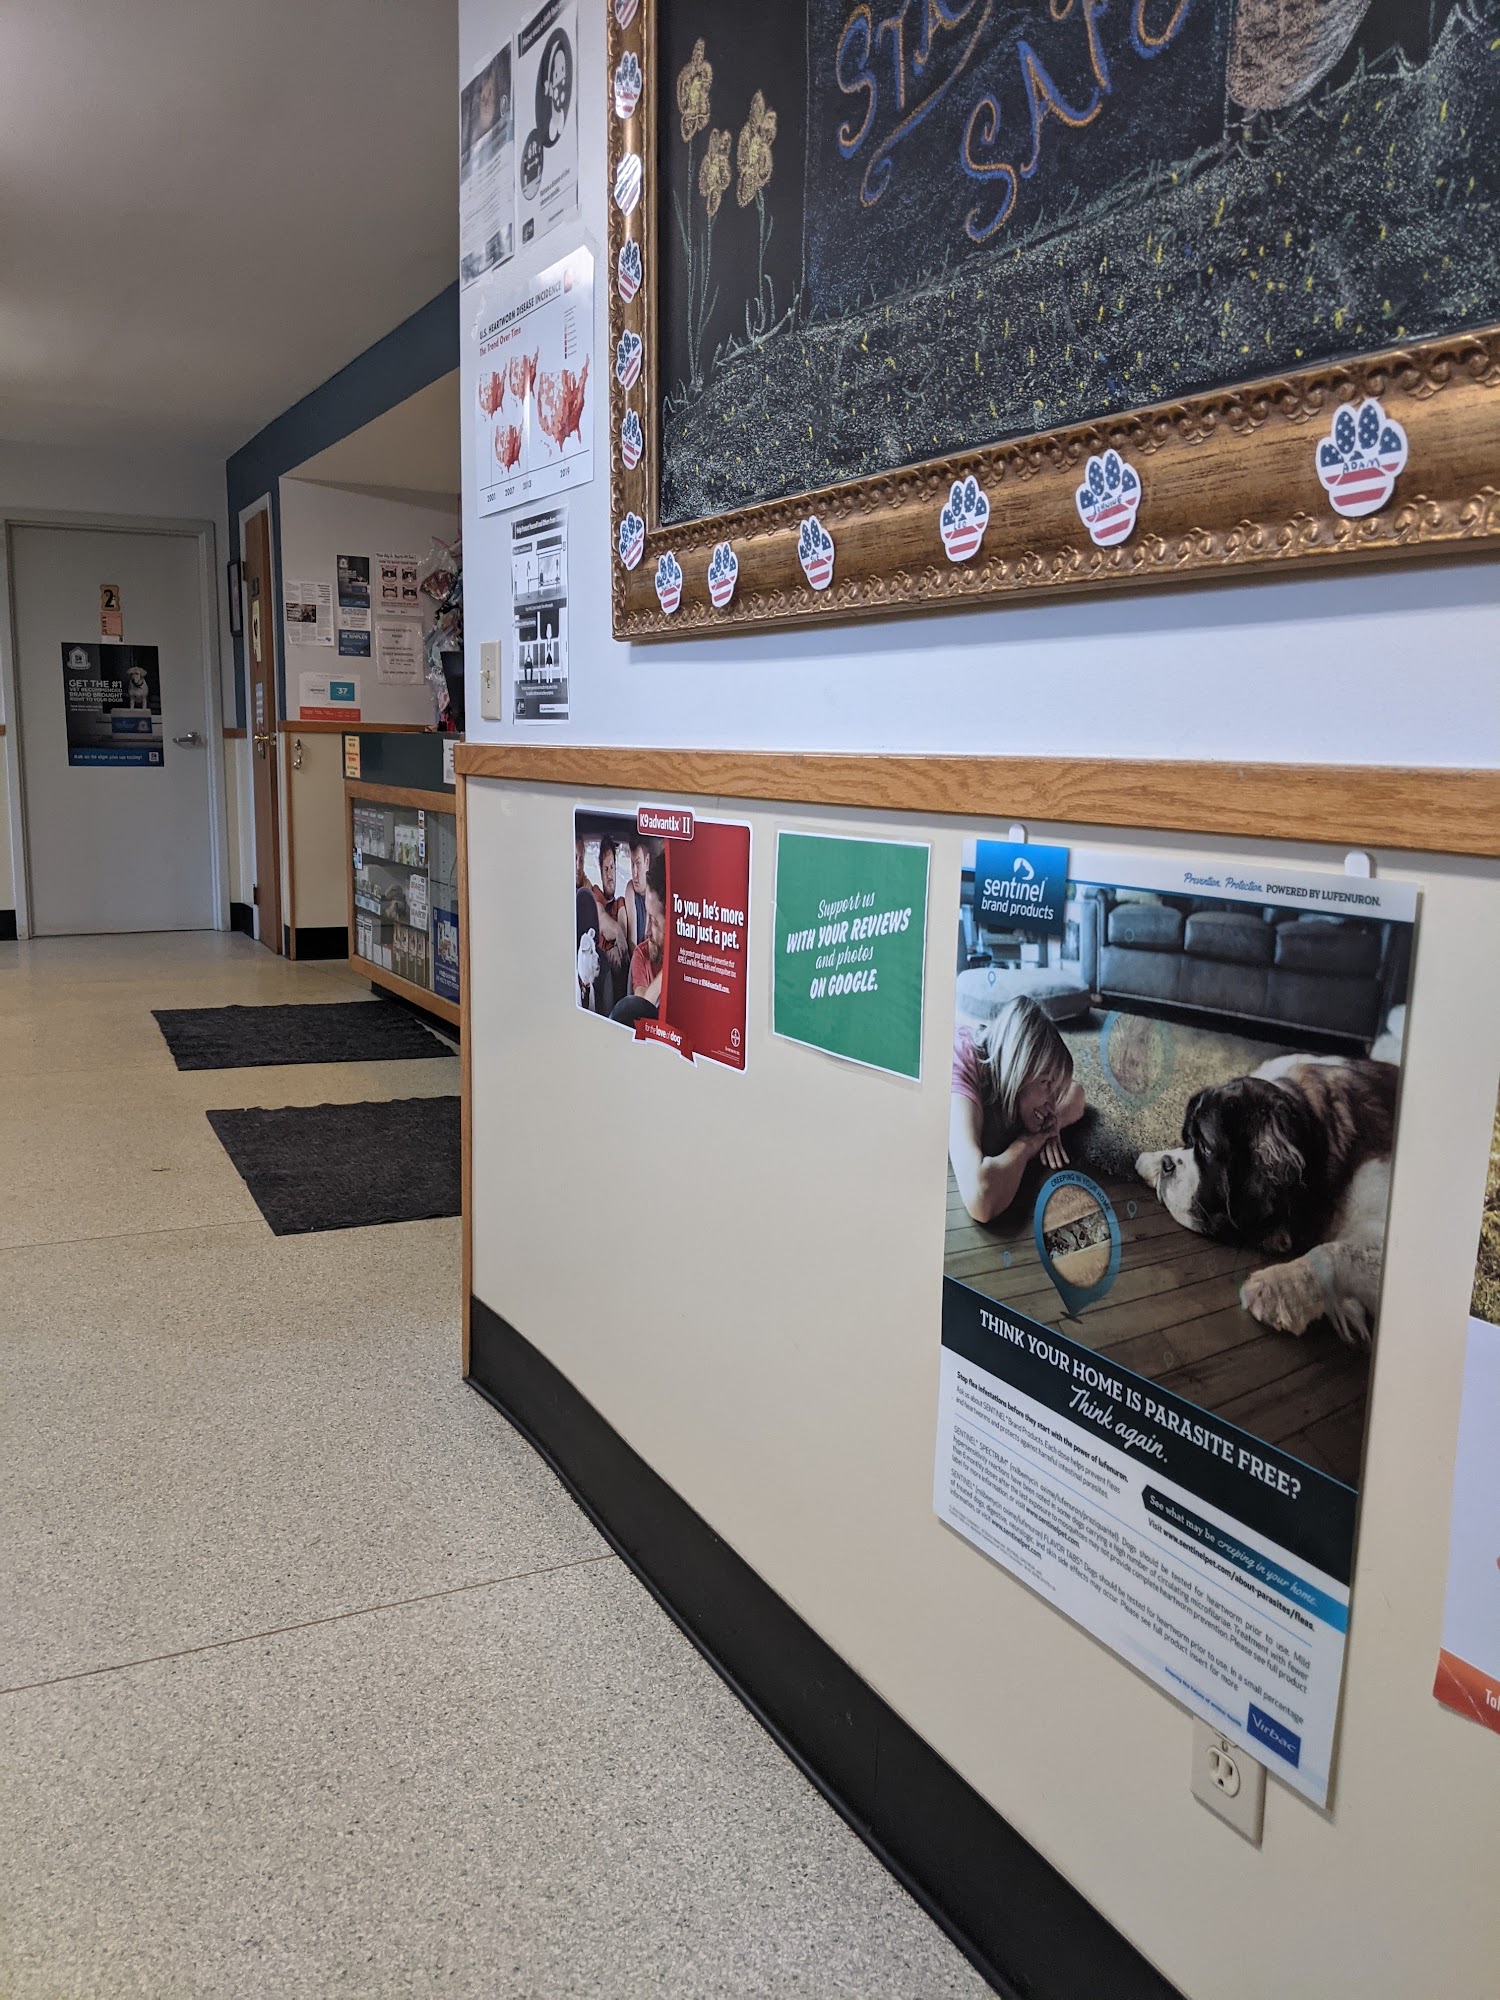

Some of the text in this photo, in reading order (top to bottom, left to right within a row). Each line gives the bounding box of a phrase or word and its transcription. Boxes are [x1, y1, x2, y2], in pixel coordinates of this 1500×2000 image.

[488, 309, 516, 335] HEARTWORM
[516, 297, 534, 317] DISEASE
[535, 280, 562, 305] INCIDENCE
[479, 326, 522, 357] The Trend Over Time
[559, 466, 571, 479] 2019
[1343, 458, 1381, 475] ADAM
[103, 589, 115, 608] 2
[69, 679, 123, 689] GET THE #1
[817, 891, 876, 922] Support us
[982, 876, 1047, 903] sentinel
[1266, 884, 1308, 898] POWERED
[1308, 889, 1321, 900] BY
[1321, 890, 1382, 907] LUFENURON.
[672, 893, 744, 927] To you, he's more
[981, 896, 1055, 920] brand products
[676, 916, 740, 951] than just a pet.
[786, 907, 913, 954] WITH YOUR REVIEWS
[815, 944, 875, 971] and photos
[809, 968, 879, 1000] ON GOOGLE.
[655, 1024, 666, 1039] love
[670, 1030, 681, 1046] dog
[1050, 1172, 1111, 1213] CREEPING IN YOUR HOME
[956, 1369, 968, 1386] Stop
[968, 1377, 978, 1390] flea
[977, 1382, 1007, 1408] infestations
[1007, 1400, 1024, 1418] before
[1024, 1411, 1036, 1428] they
[1036, 1419, 1050, 1435] start
[1050, 1427, 1063, 1442] with
[1062, 1435, 1072, 1448] the
[1073, 1442, 1090, 1462] power
[1090, 1451, 1098, 1464] of
[978, 1308, 1303, 1500] THINK YOUR HOME IS PARASITE FREE?
[990, 1417, 999, 1430] and
[999, 1423, 1020, 1444] protects
[1067, 1383, 1169, 1464] Think again.
[1007, 1416, 1022, 1432] Brand
[1044, 1438, 1057, 1455] Each
[1057, 1447, 1070, 1463] dose
[1069, 1455, 1085, 1474] helps
[1084, 1465, 1106, 1487] prevent
[1106, 1477, 1121, 1494] fleas
[1149, 1493, 1164, 1512] See
[1164, 1502, 1185, 1525] what
[1185, 1518, 1203, 1538] may
[1203, 1527, 1216, 1544] be
[1216, 1536, 1255, 1573] creeping
[1254, 1559, 1266, 1575] in
[1265, 1567, 1289, 1594] your
[1147, 1516, 1316, 1634] Visit www.sentinelpet.com/about-parasites/fleas.
[1121, 1535, 1137, 1556] Dogs
[1138, 1547, 1159, 1569] should
[1171, 1569, 1192, 1592] tested
[1193, 1584, 1204, 1600] for
[1205, 1592, 1243, 1626] heartworm
[1244, 1619, 1263, 1640] prior
[1275, 1640, 1291, 1658] use.
[1293, 1650, 1310, 1671] Mild
[1089, 1578, 1101, 1594] may
[1119, 1598, 1139, 1620] Please
[1163, 1631, 1189, 1658] product
[1220, 1672, 1238, 1692] more
[1250, 1712, 1297, 1756] Virbac
